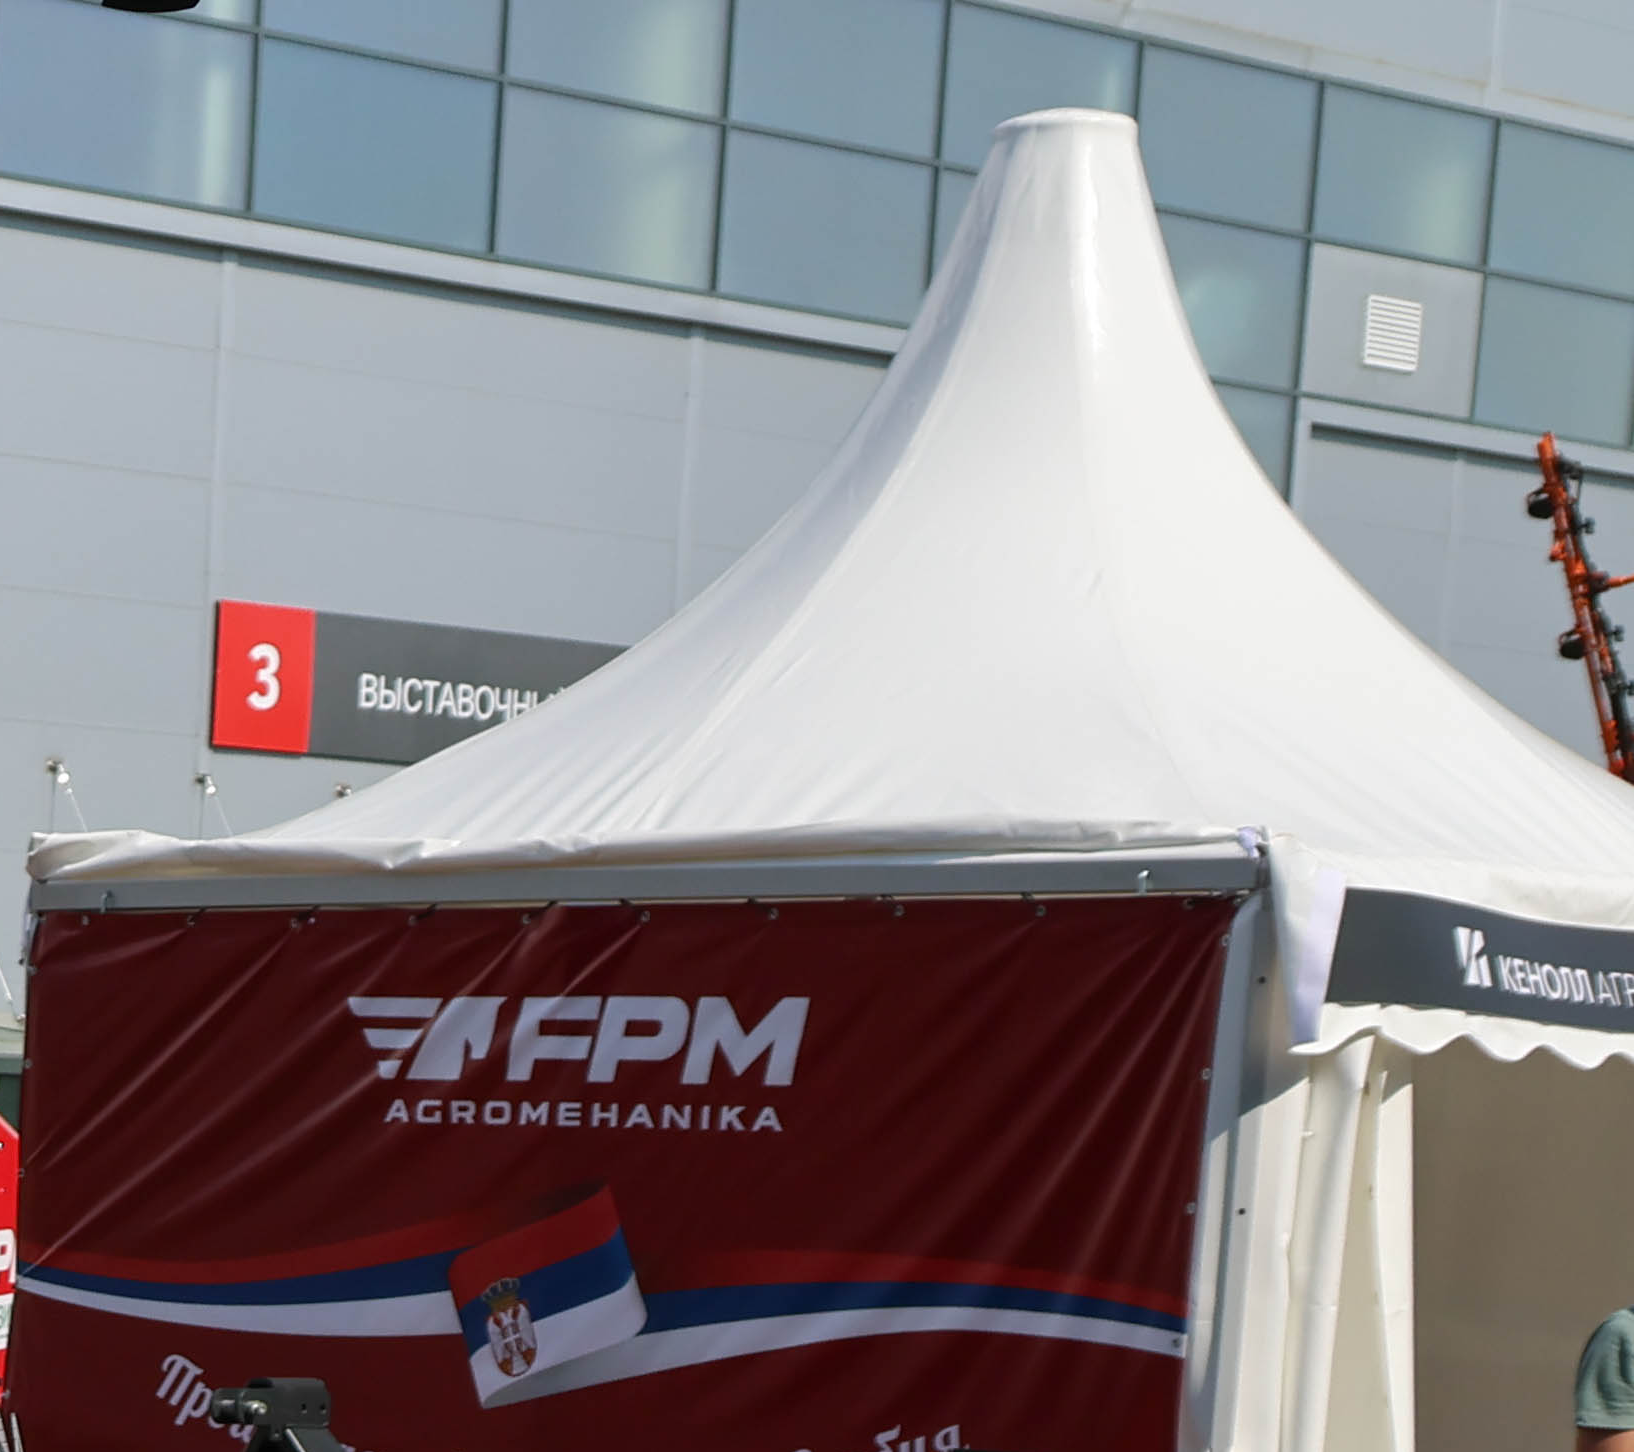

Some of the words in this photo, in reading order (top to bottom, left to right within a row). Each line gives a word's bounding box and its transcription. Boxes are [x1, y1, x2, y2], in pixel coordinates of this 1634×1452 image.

[246, 643, 282, 712] 3
[358, 673, 565, 722] ВЫСТАВОЧН
[1498, 954, 1595, 1005] КЕНОЛЛ
[505, 996, 811, 1087] FPM
[384, 1099, 784, 1133] AGROMEHANIKA
